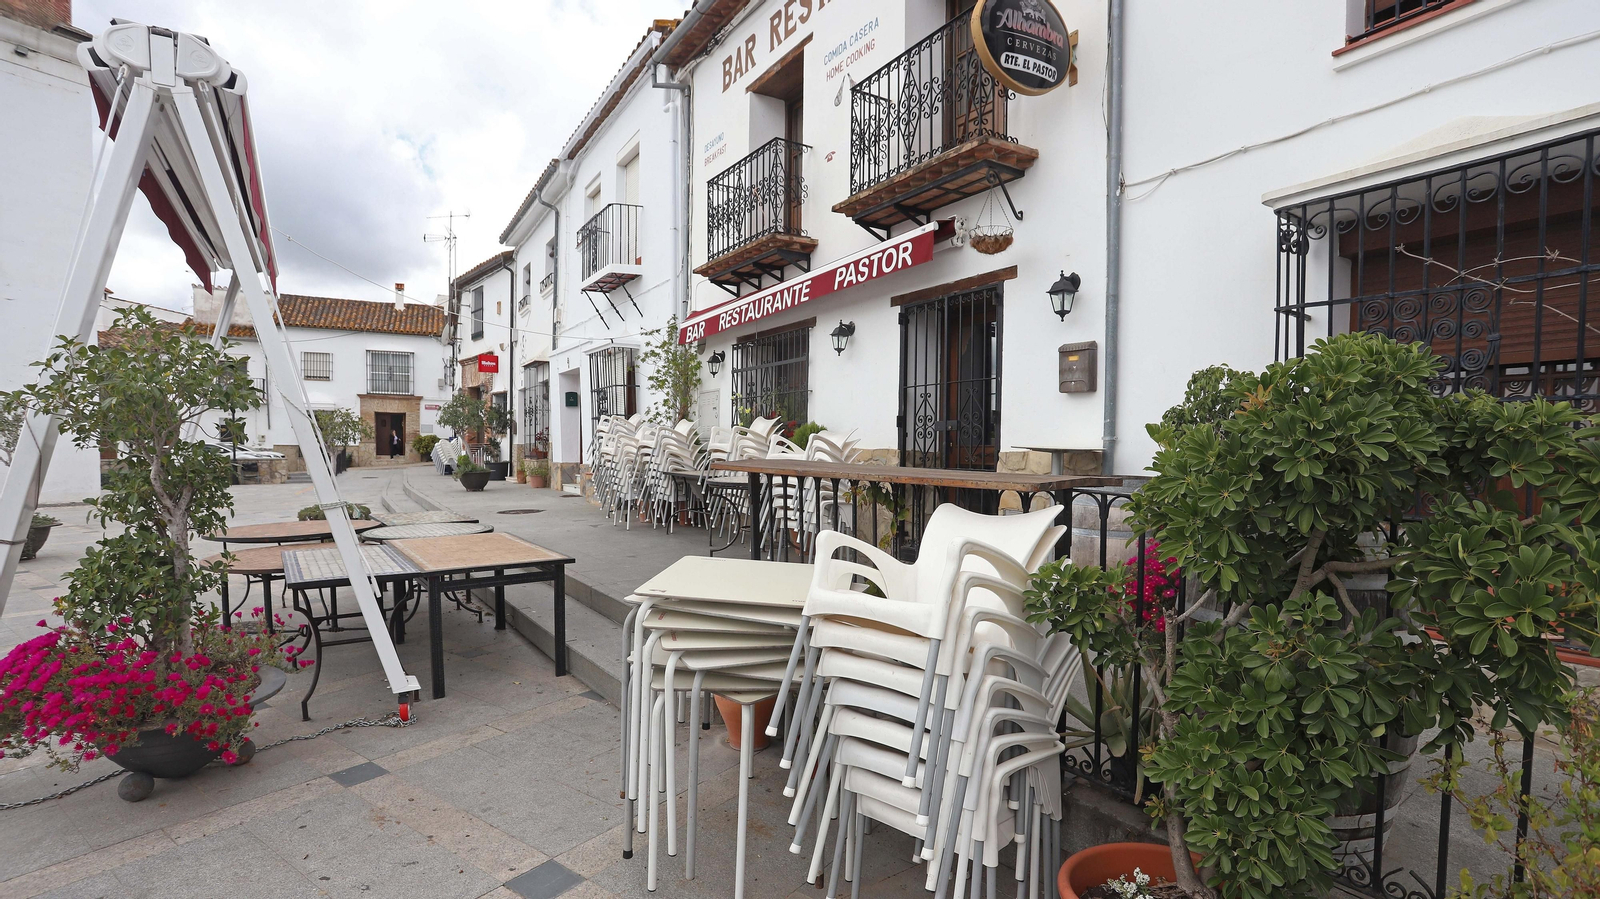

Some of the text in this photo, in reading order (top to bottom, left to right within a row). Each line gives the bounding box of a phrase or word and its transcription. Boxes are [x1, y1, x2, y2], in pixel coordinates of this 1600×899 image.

[823, 16, 879, 66] COMIDA CASERA
[996, 8, 1064, 49] Alhambra
[1007, 37, 1057, 61] CERVEZAS
[722, 33, 756, 94] BAR
[826, 38, 876, 82] HOME COOKING
[1004, 54, 1057, 81] RTE. EL PASTOR
[686, 241, 913, 343] BAR RESTAURANTE PASTOR
